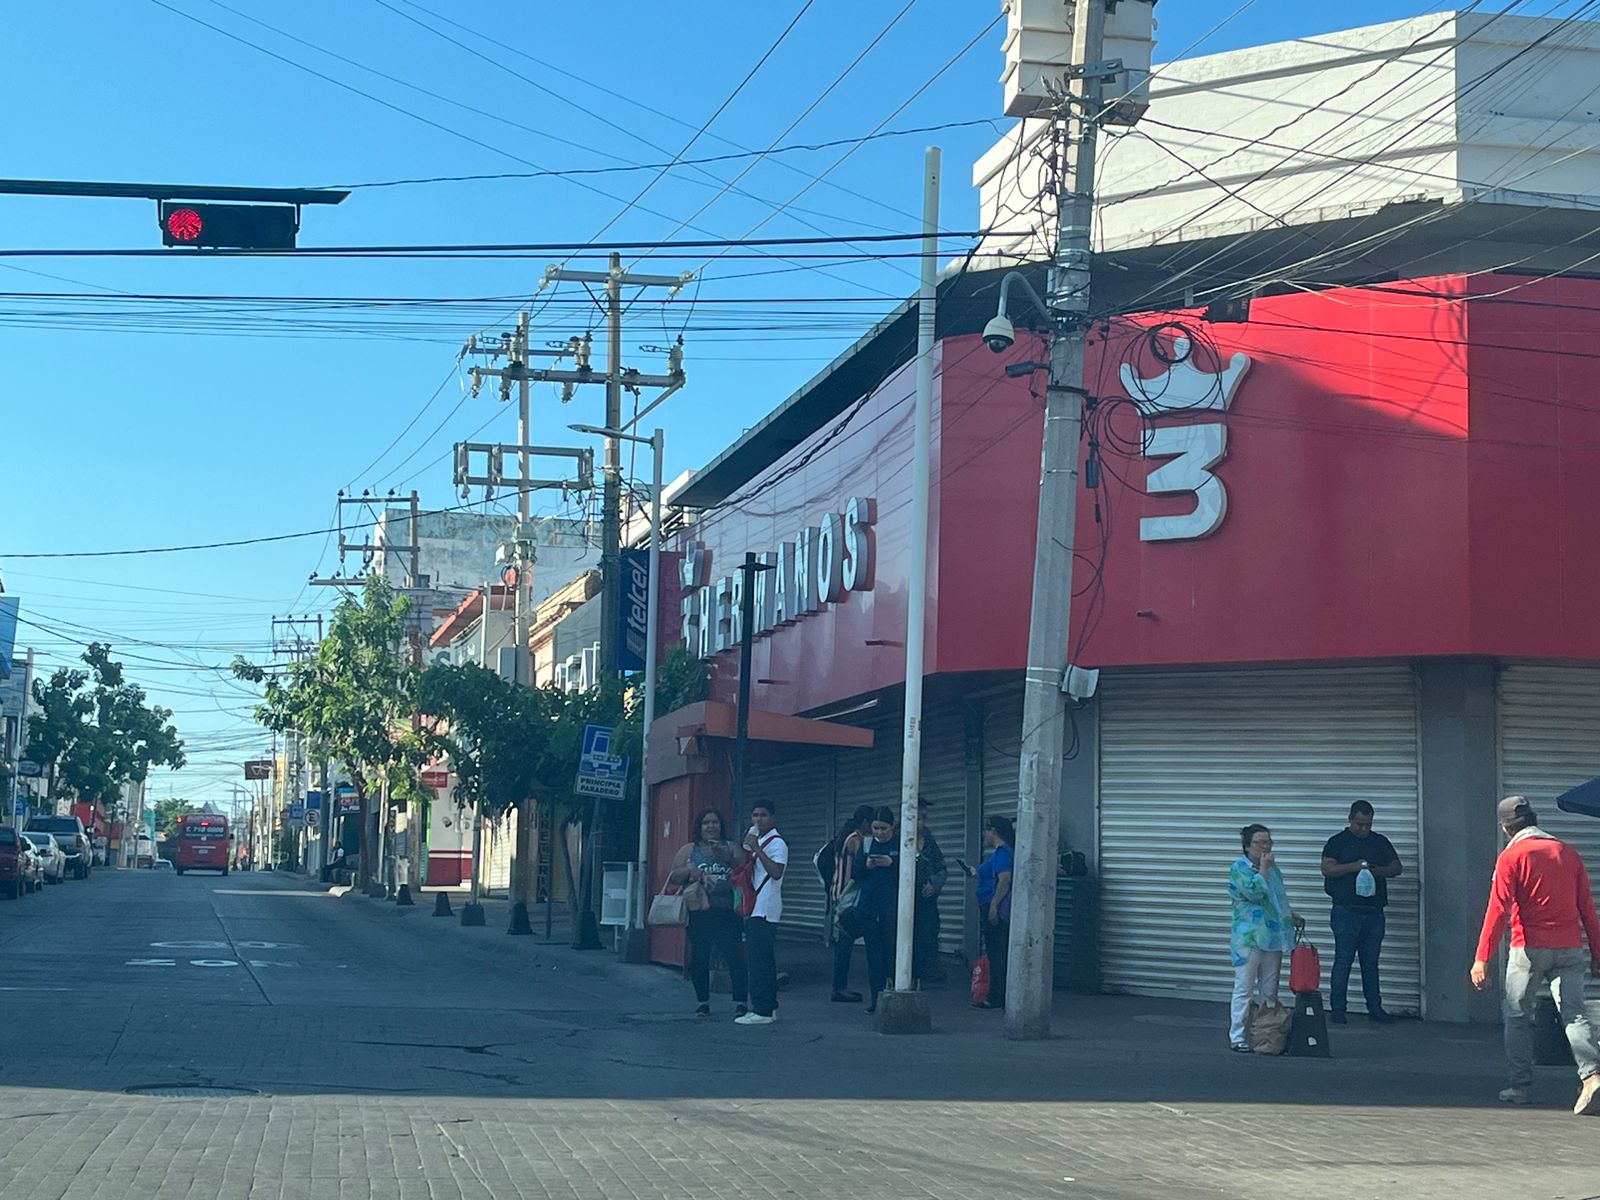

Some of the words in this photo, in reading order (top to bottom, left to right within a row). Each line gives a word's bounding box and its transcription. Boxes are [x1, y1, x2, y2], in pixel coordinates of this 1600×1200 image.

[1140, 422, 1228, 543] 3
[627, 556, 648, 634] telcel
[698, 496, 876, 661] HERMANOS
[580, 785, 620, 795] PARADERO
